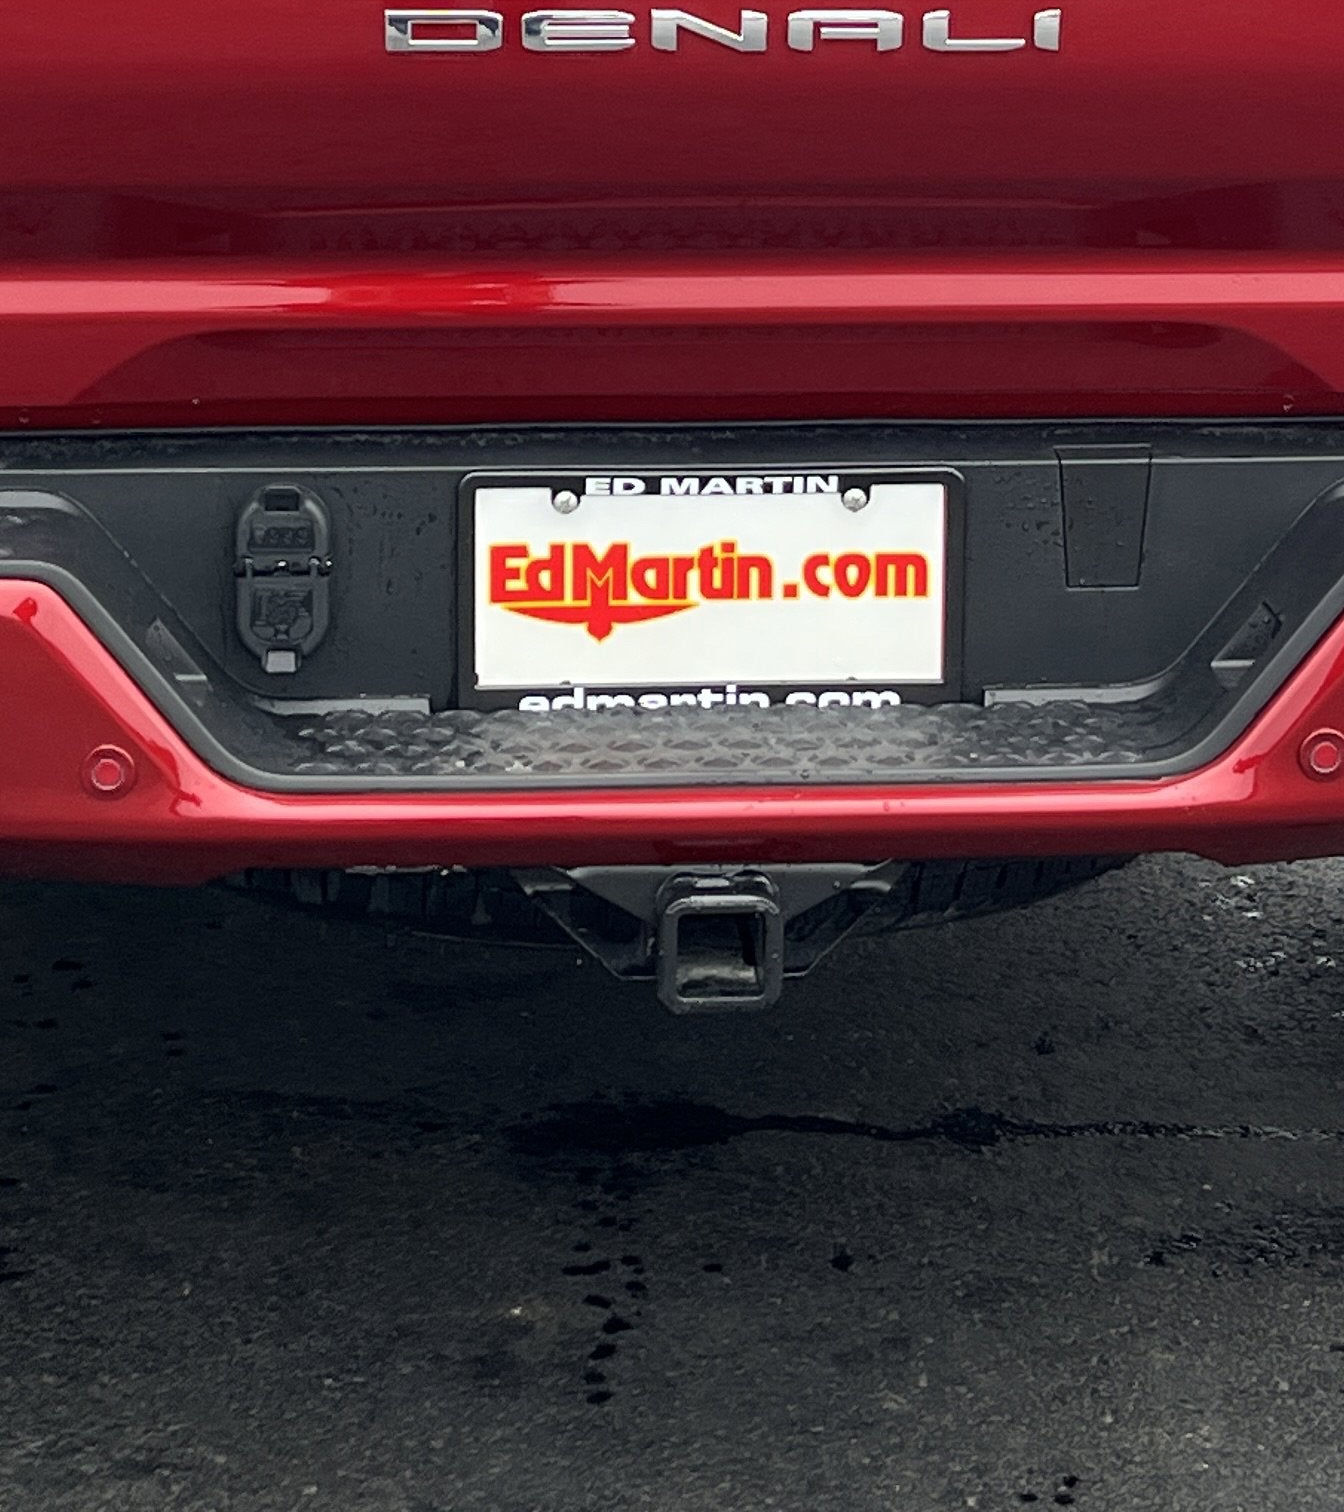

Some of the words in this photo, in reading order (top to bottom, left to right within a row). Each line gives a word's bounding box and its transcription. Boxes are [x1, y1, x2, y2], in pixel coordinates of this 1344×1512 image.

[384, 8, 1061, 51] DENALI
[586, 476, 647, 495] ED
[660, 475, 839, 495] MARTIN
[488, 540, 929, 605] EdMartin.com
[518, 684, 902, 711] edmartincom
